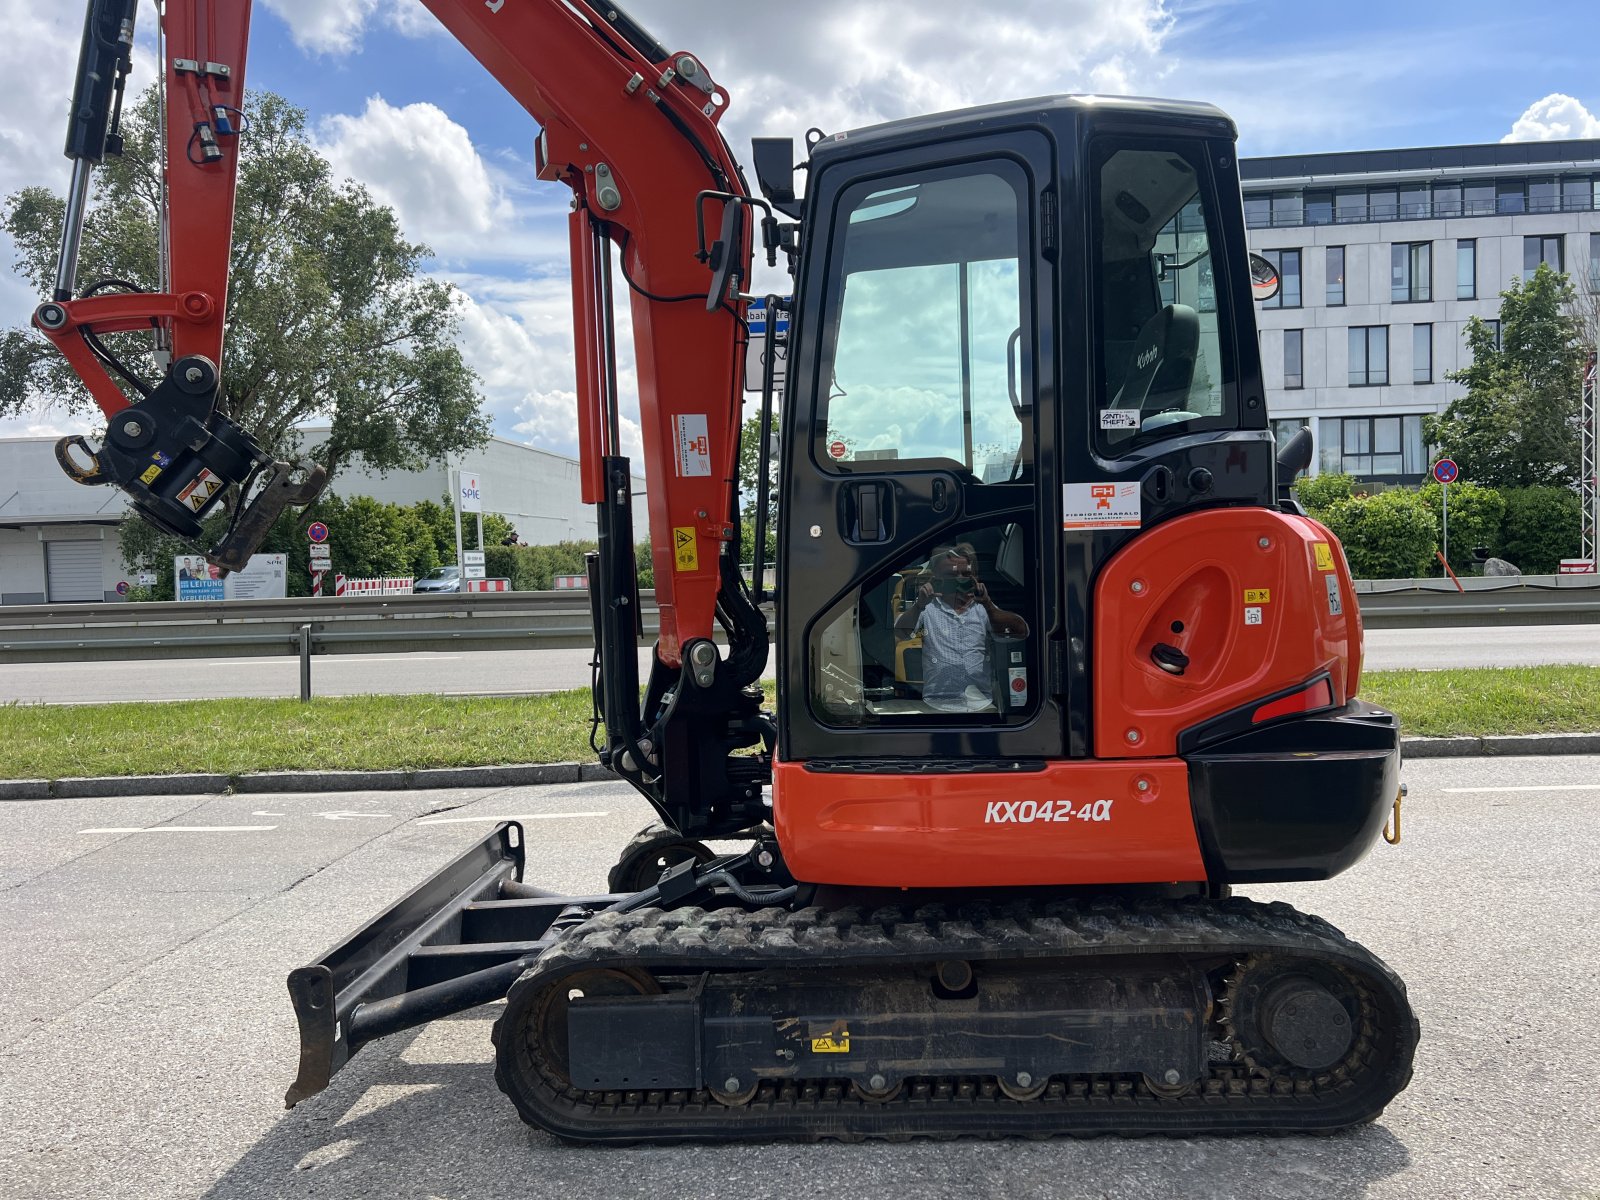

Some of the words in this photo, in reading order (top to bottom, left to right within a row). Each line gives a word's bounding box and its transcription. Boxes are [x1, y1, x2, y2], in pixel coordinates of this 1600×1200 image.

[1137, 344, 1158, 369] Kubota
[462, 488, 480, 499] SPIE
[1093, 487, 1113, 496] FH
[190, 580, 223, 588] LEITUNG
